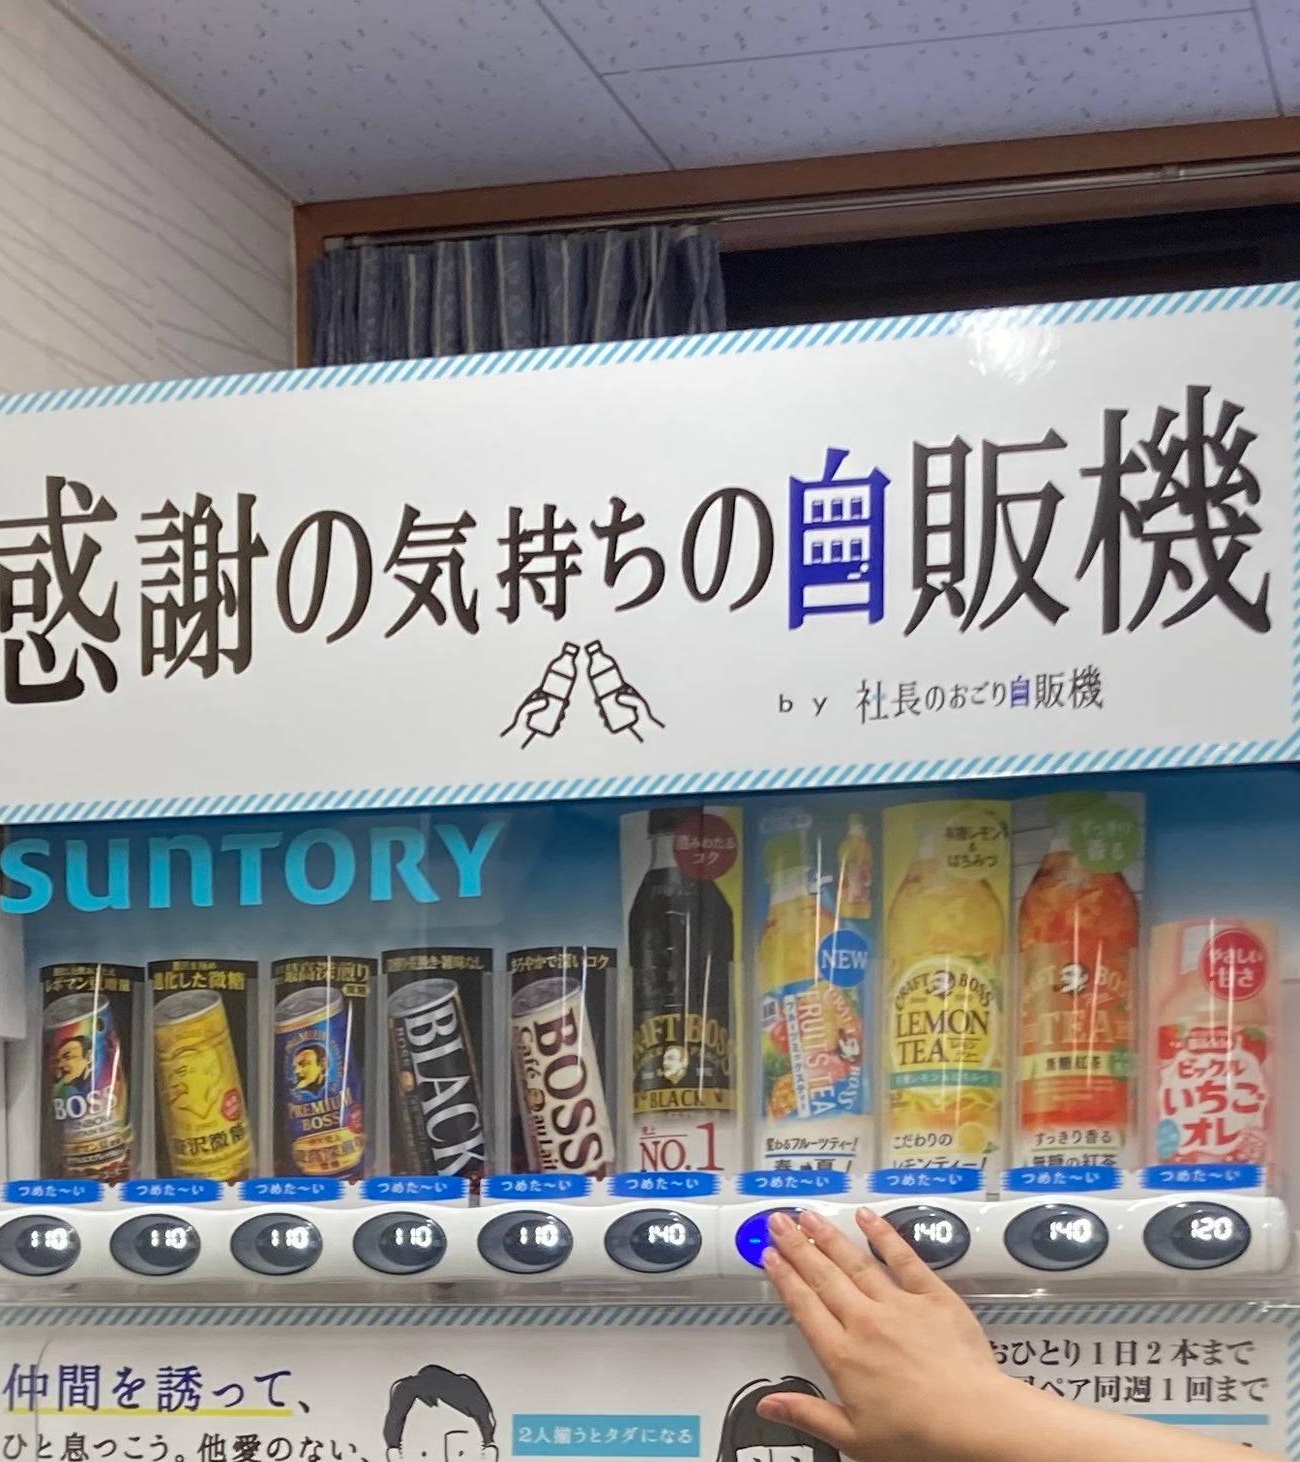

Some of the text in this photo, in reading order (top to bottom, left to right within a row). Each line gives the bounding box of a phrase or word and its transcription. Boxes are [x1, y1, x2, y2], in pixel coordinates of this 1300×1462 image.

[778, 663, 1104, 725] by 社長のおごり自販機
[0, 821, 504, 914] SUNTORY
[821, 949, 868, 971] NEW
[798, 990, 830, 1070] FRUITS
[896, 1008, 990, 1038] LEMON
[897, 1038, 948, 1066] TEA
[54, 1086, 117, 1121] BOSS
[404, 1001, 488, 1176] BLACK
[534, 1007, 605, 1174] BOSS
[649, 1088, 706, 1108] BLACK
[808, 1072, 837, 1116] TEA
[1164, 1080, 1264, 1117] いちご
[302, 1113, 342, 1132] BOSS
[1034, 1129, 1113, 1146] すっきり香る
[1182, 1117, 1239, 1148] オレ
[639, 1121, 725, 1173] NO.1
[893, 1133, 953, 1150] こだわりの
[649, 1223, 686, 1245] 140
[913, 1220, 953, 1244] 140
[1049, 1218, 1091, 1242] 140
[1191, 1216, 1233, 1241] 120
[3, 1363, 311, 1413] 仲間を誘って、
[519, 1426, 694, 1444] 2人揃うとタダになる
